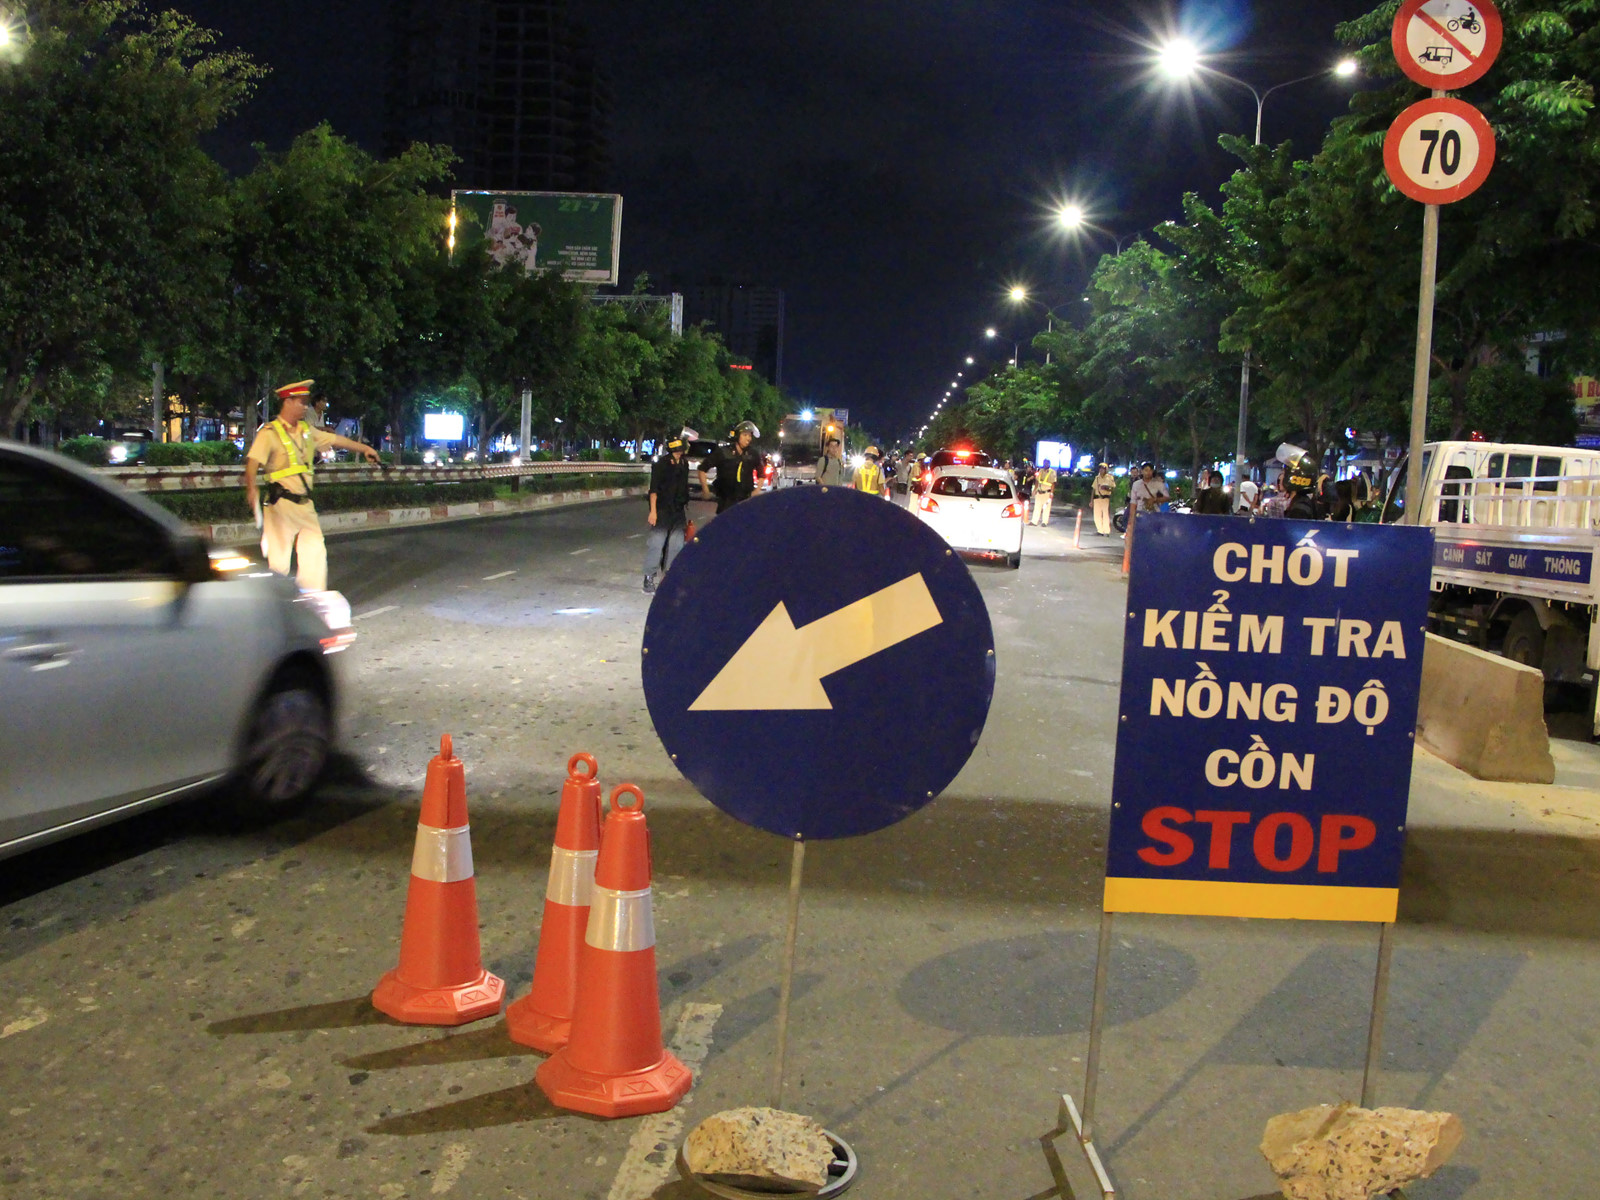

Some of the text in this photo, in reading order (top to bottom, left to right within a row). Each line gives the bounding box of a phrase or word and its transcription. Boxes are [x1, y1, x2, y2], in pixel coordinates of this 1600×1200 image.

[1420, 129, 1461, 176] 70
[1212, 529, 1359, 588] CHỐT
[1475, 548, 1493, 566] SÁT
[1544, 555, 1581, 576] THÔNG
[1142, 589, 1407, 659] KIỂM TRA
[1149, 661, 1389, 736] NỒNG ĐỘ
[1204, 734, 1315, 791] CỒN
[1137, 806, 1377, 873] STOP
